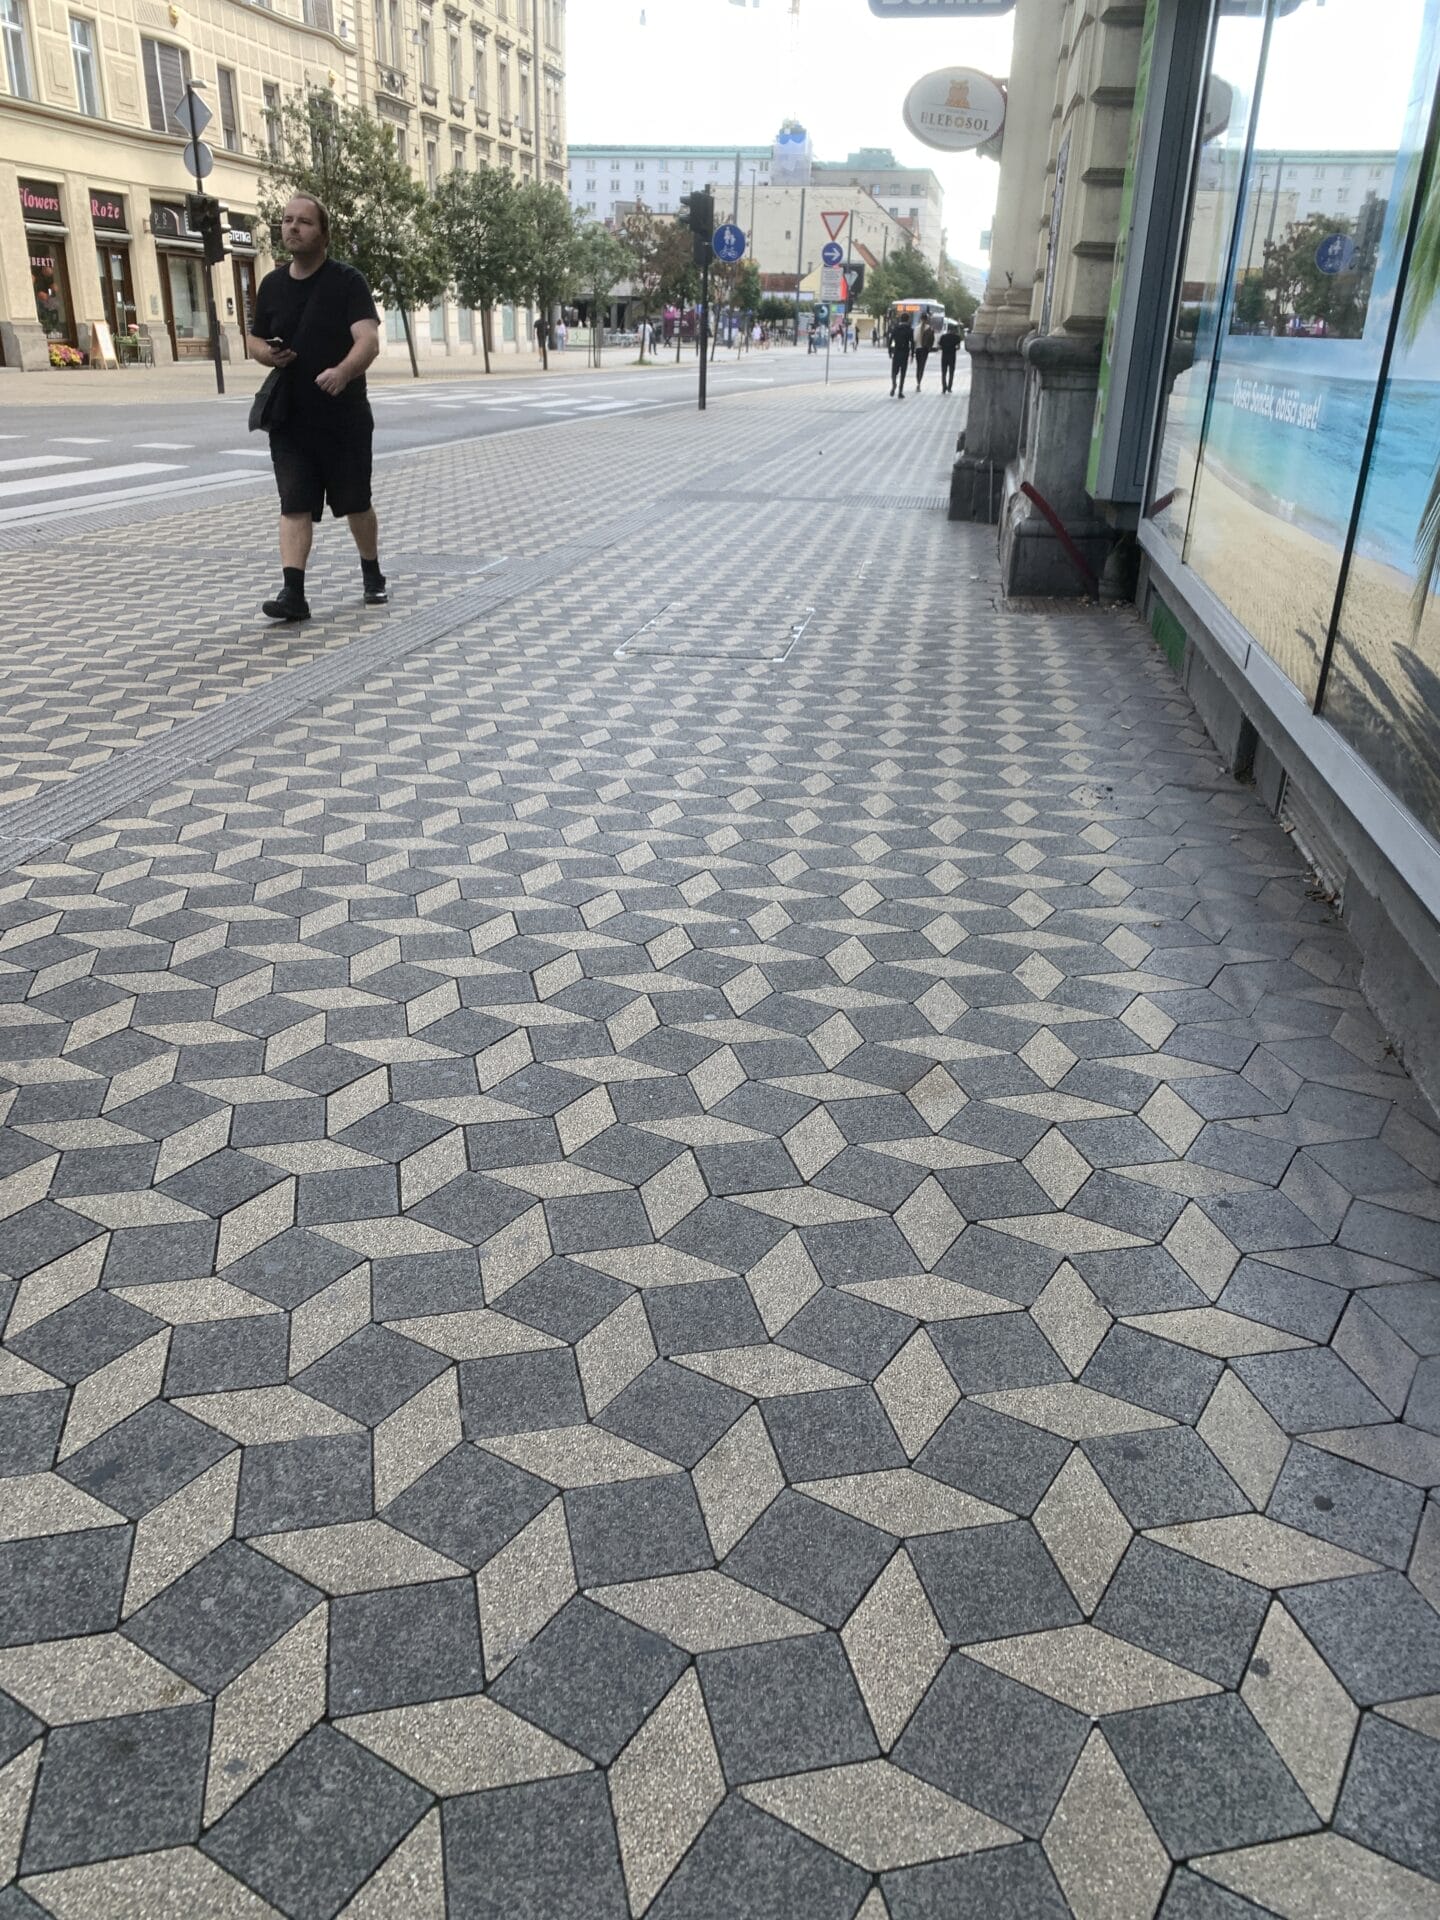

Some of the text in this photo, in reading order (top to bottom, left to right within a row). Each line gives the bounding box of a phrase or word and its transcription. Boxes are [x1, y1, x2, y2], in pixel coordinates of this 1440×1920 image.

[920, 111, 990, 132] HLEBOSOL
[91, 199, 121, 219] Rože
[30, 256, 56, 268] BERTY
[1297, 393, 1322, 430] svet!
